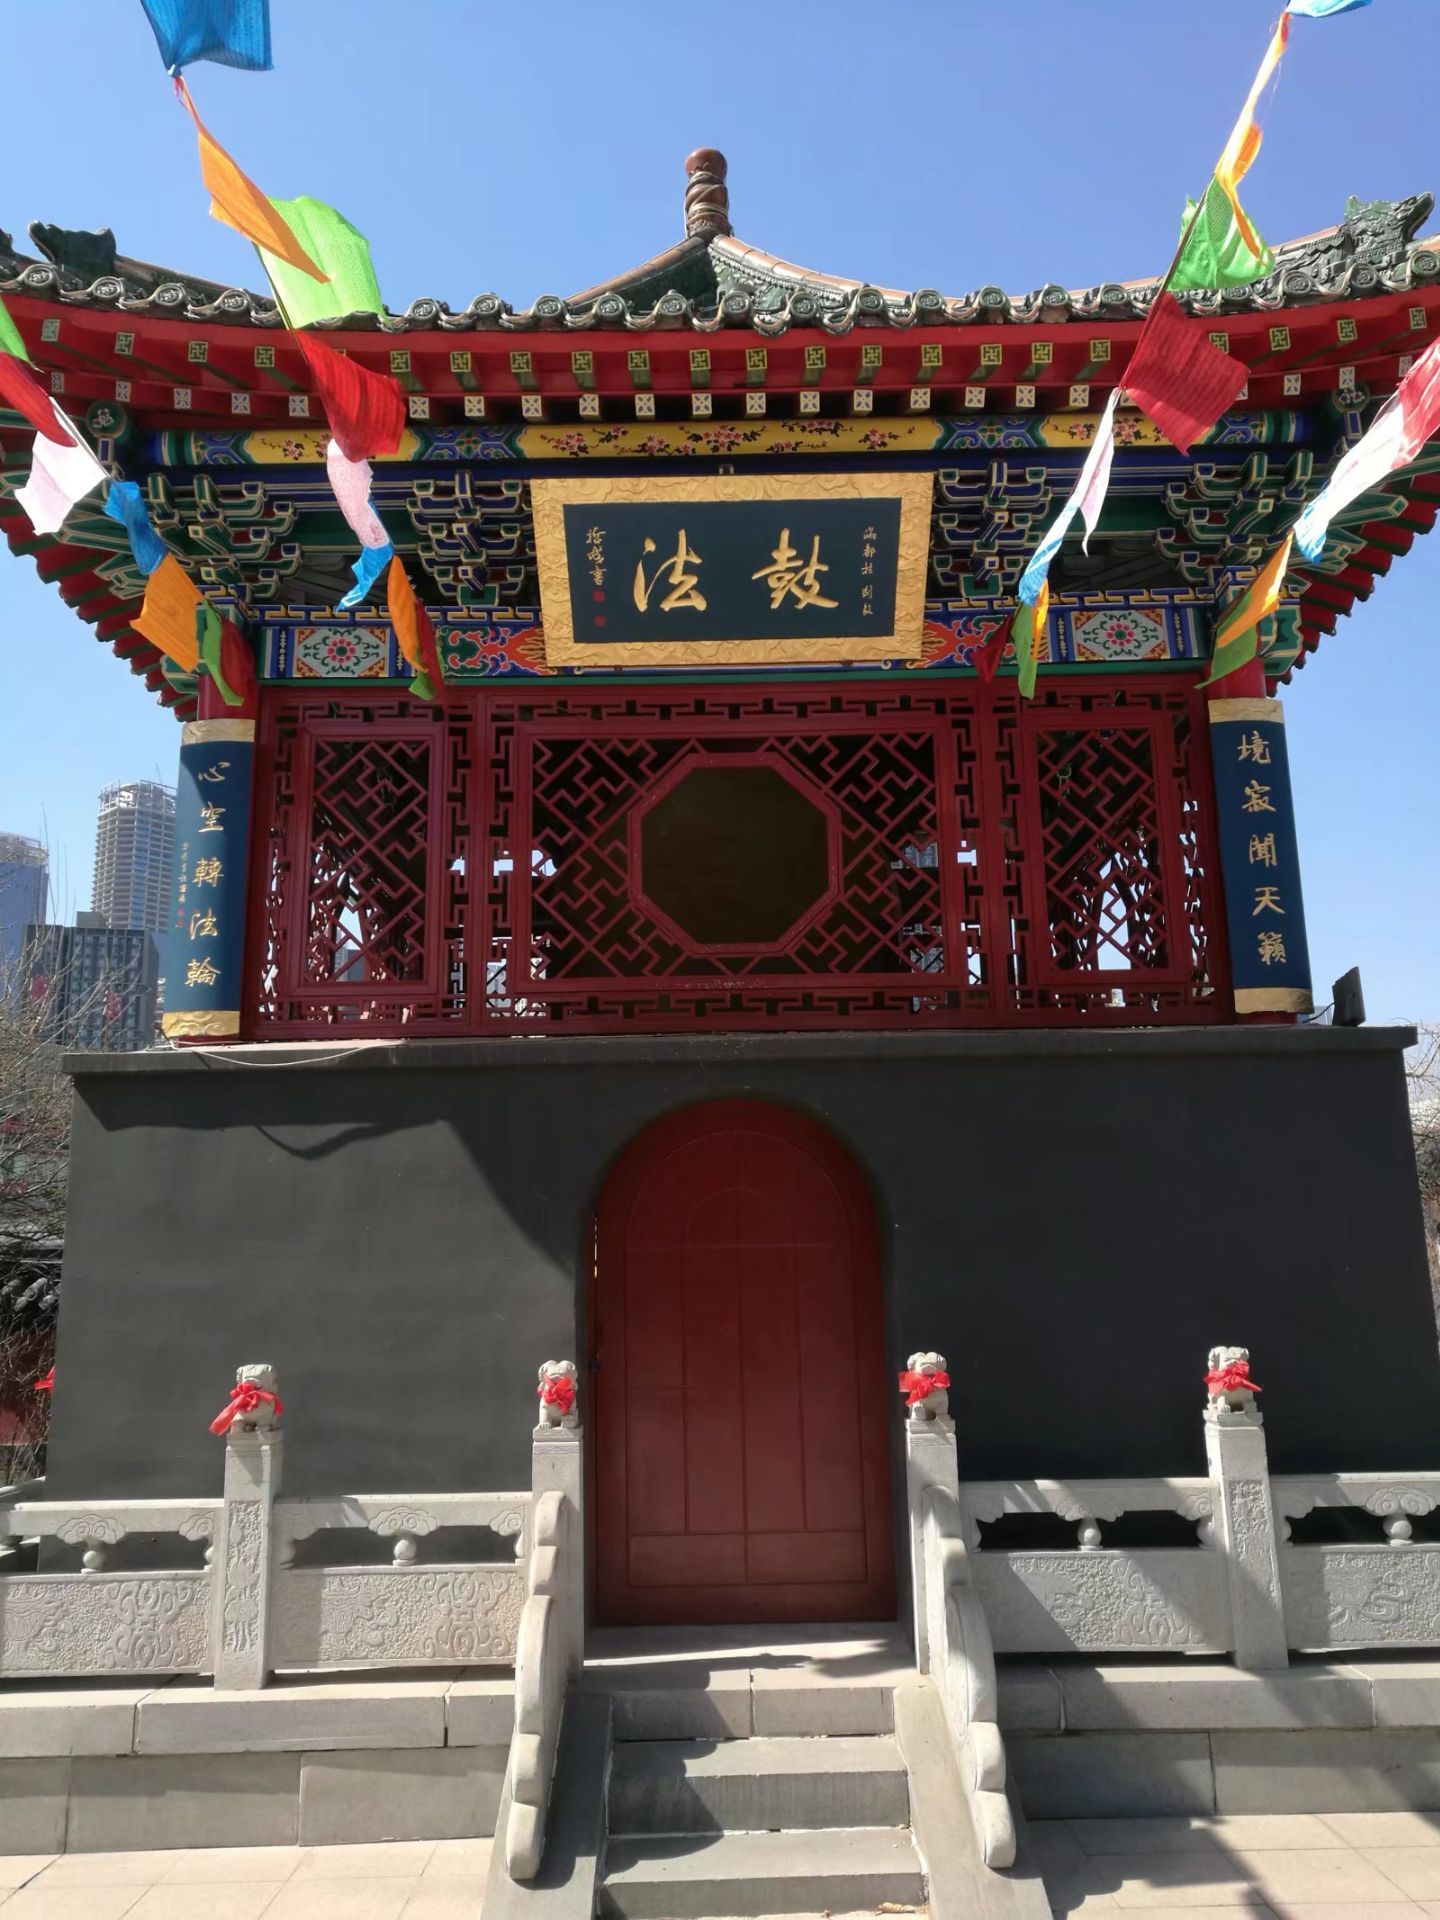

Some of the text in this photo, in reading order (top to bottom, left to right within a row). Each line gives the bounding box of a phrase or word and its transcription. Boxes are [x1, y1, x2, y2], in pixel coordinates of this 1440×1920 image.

[185, 760, 231, 987] 心空轉法輪
